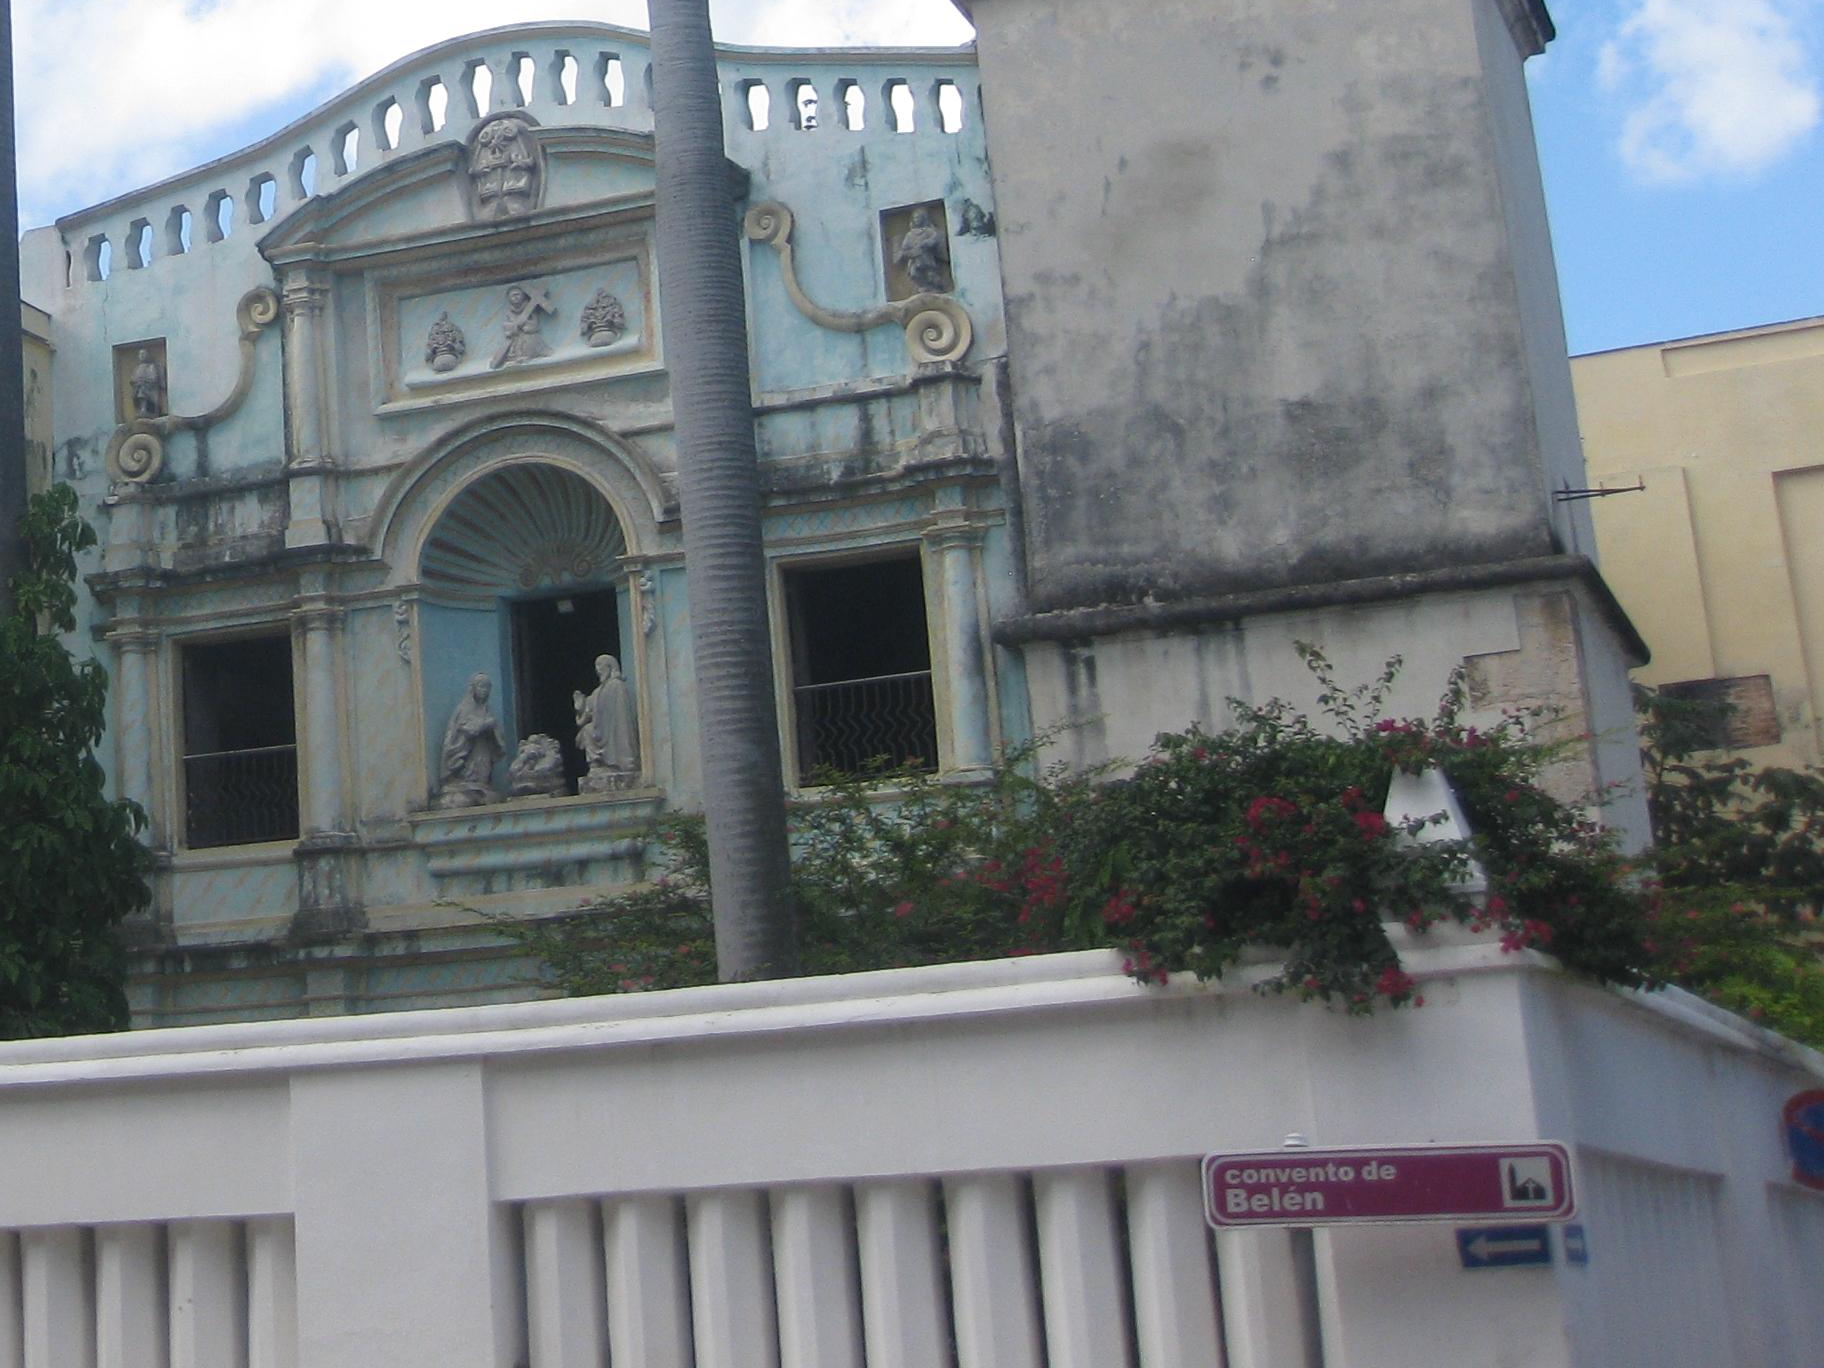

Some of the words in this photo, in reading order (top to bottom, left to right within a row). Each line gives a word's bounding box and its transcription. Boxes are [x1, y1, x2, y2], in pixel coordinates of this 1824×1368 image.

[1224, 1162, 1356, 1184] convento
[1361, 1160, 1397, 1181] de
[1225, 1186, 1325, 1213] Belén
